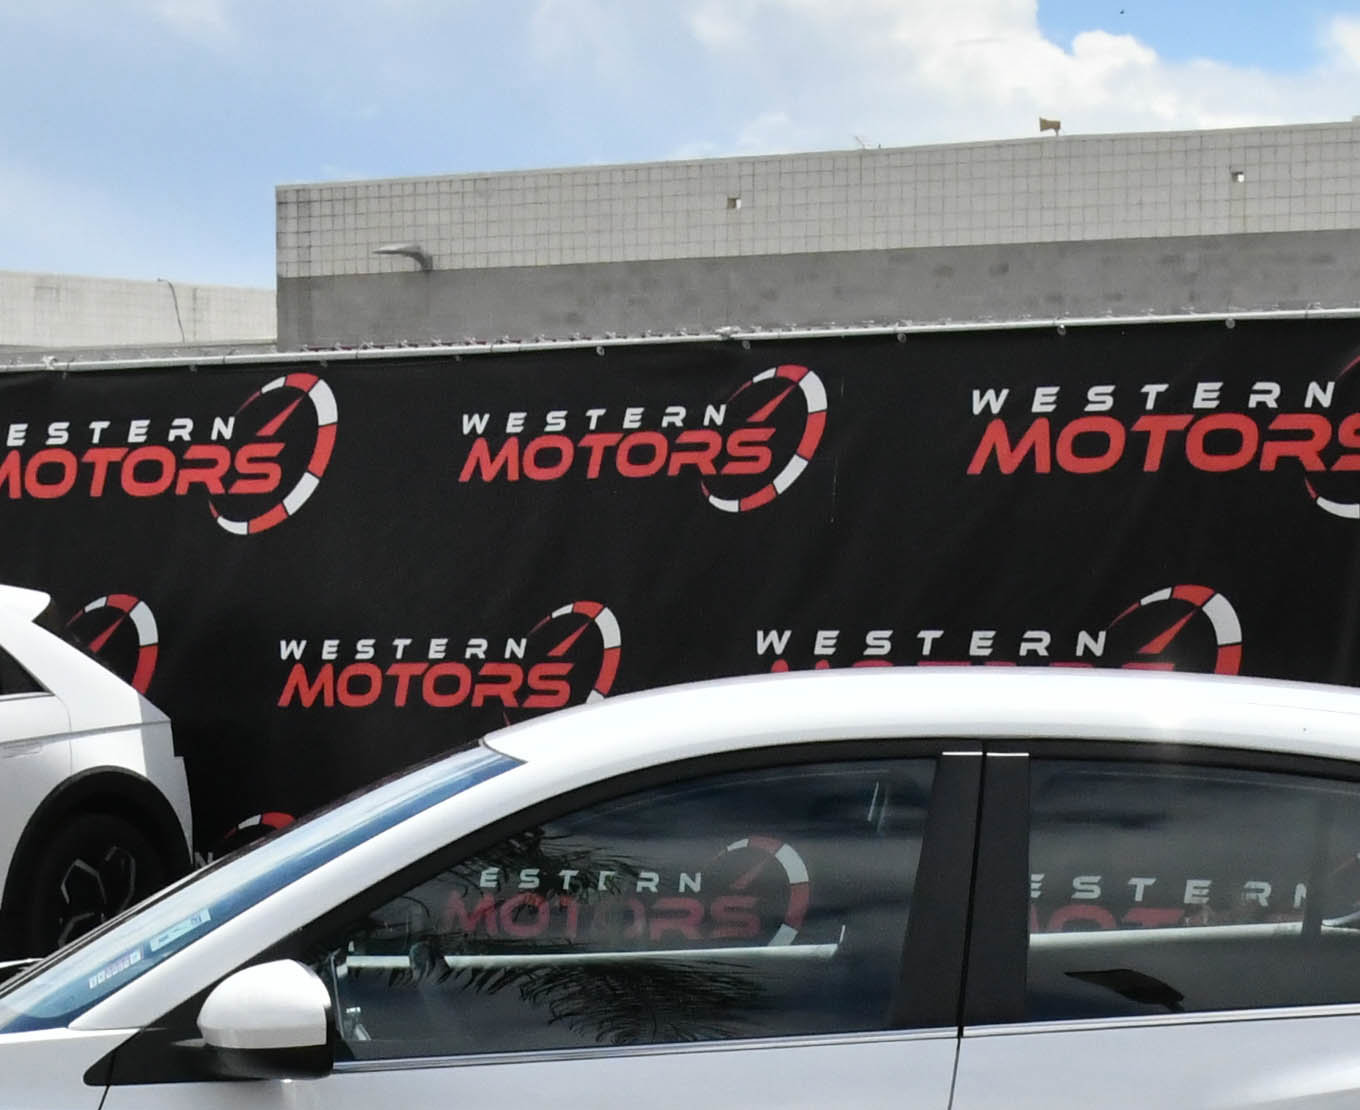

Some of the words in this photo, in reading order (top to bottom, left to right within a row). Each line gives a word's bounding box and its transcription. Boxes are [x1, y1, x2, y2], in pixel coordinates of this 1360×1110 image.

[972, 381, 1336, 416] WESTERN
[462, 403, 727, 436] WESTERN
[458, 427, 777, 483] MOTORS
[279, 637, 527, 661] WESTERN
[756, 629, 1107, 657] WESTERN
[277, 661, 574, 708] MOTORS
